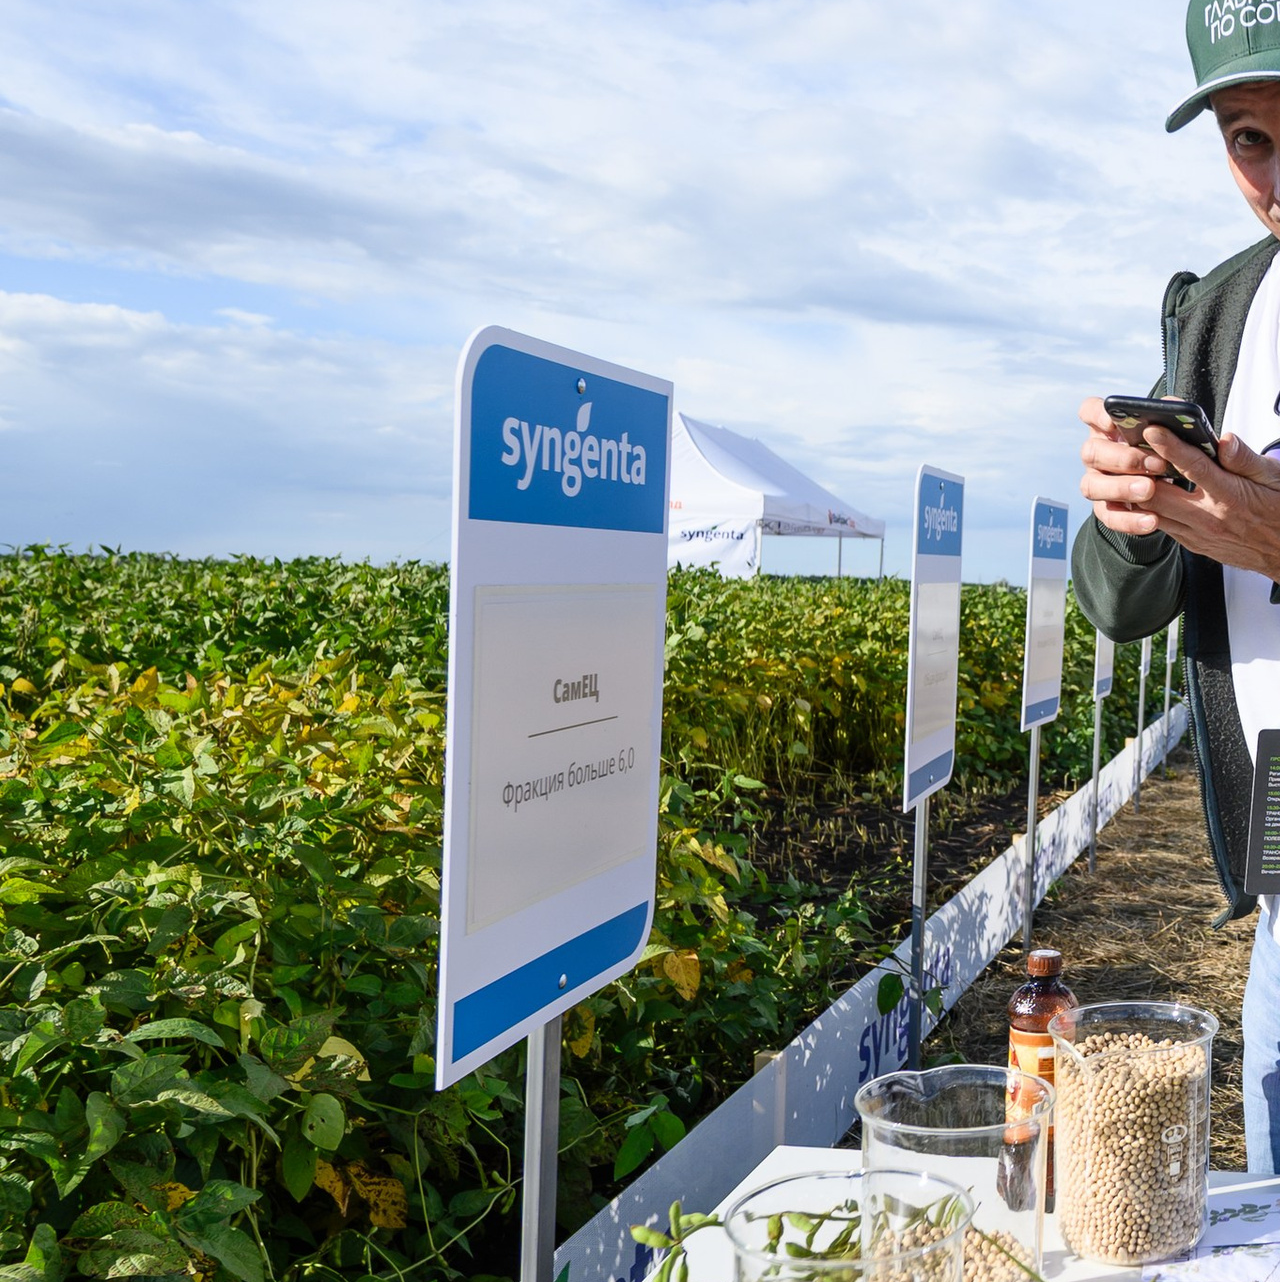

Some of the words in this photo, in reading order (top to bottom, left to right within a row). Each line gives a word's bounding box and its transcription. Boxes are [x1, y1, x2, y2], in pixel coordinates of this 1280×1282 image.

[1210, 14, 1235, 44] ПО
[501, 415, 646, 497] syngenta
[680, 528, 744, 542] syngenta
[924, 501, 958, 541] syngenta
[1037, 521, 1064, 549] syngenta
[553, 673, 600, 704] СамЕЦ
[502, 771, 565, 813] Фракция
[568, 757, 616, 788] больше
[619, 747, 635, 774] 6,0
